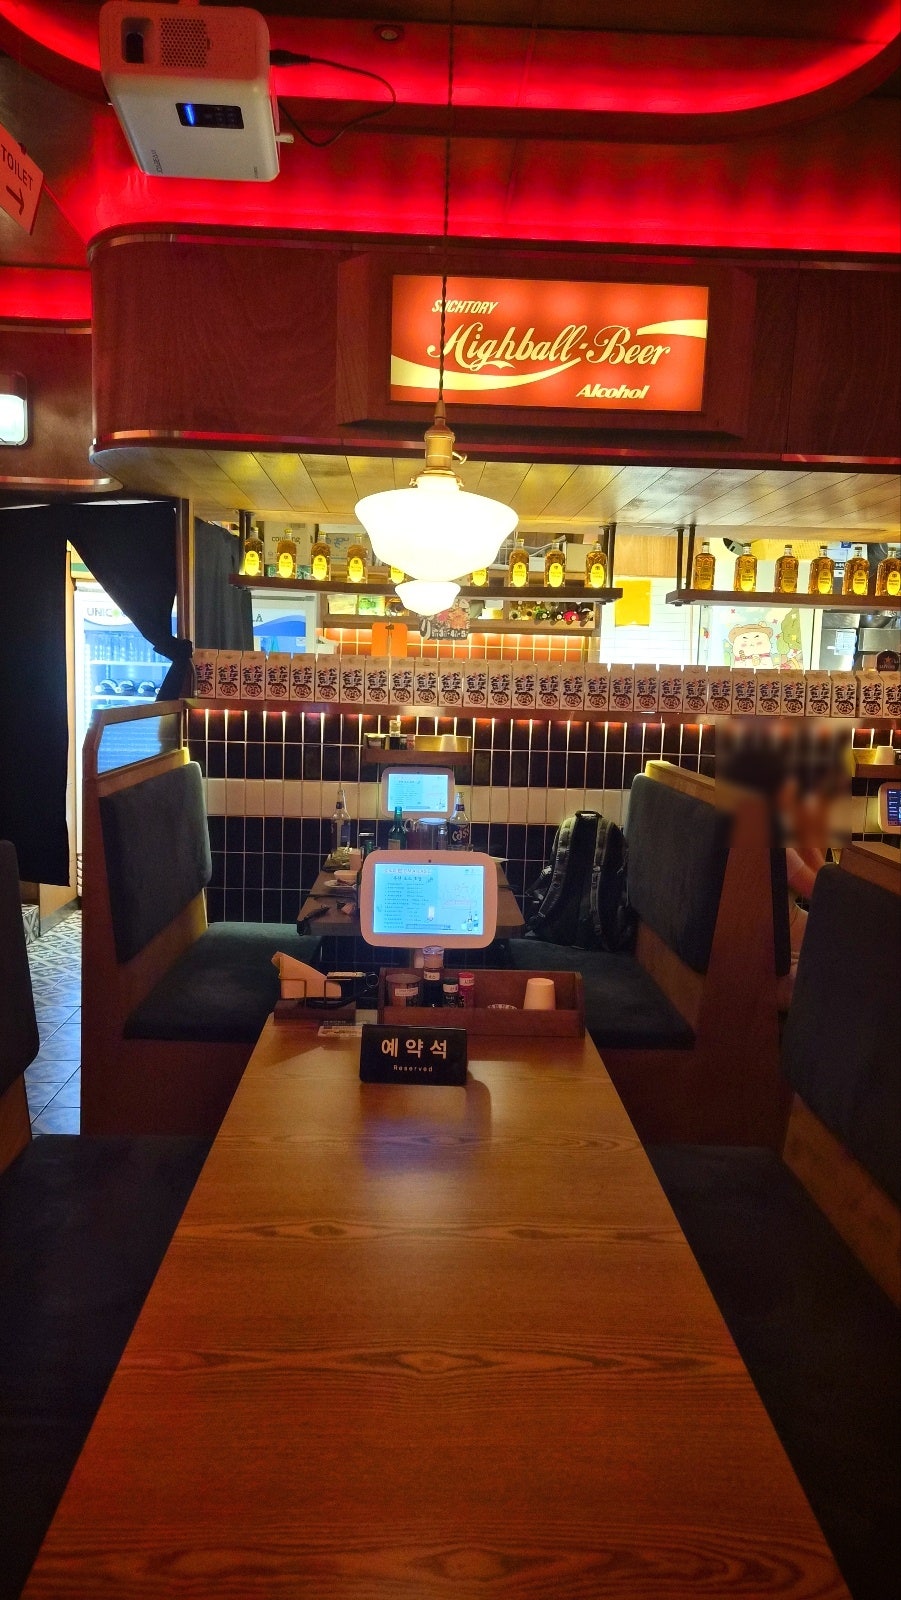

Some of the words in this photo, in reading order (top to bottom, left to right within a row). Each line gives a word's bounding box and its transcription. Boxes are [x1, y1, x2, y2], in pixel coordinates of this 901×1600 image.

[1, 143, 33, 191] TOILET
[576, 383, 651, 399] Alcohol
[393, 1064, 433, 1072] Reserved
